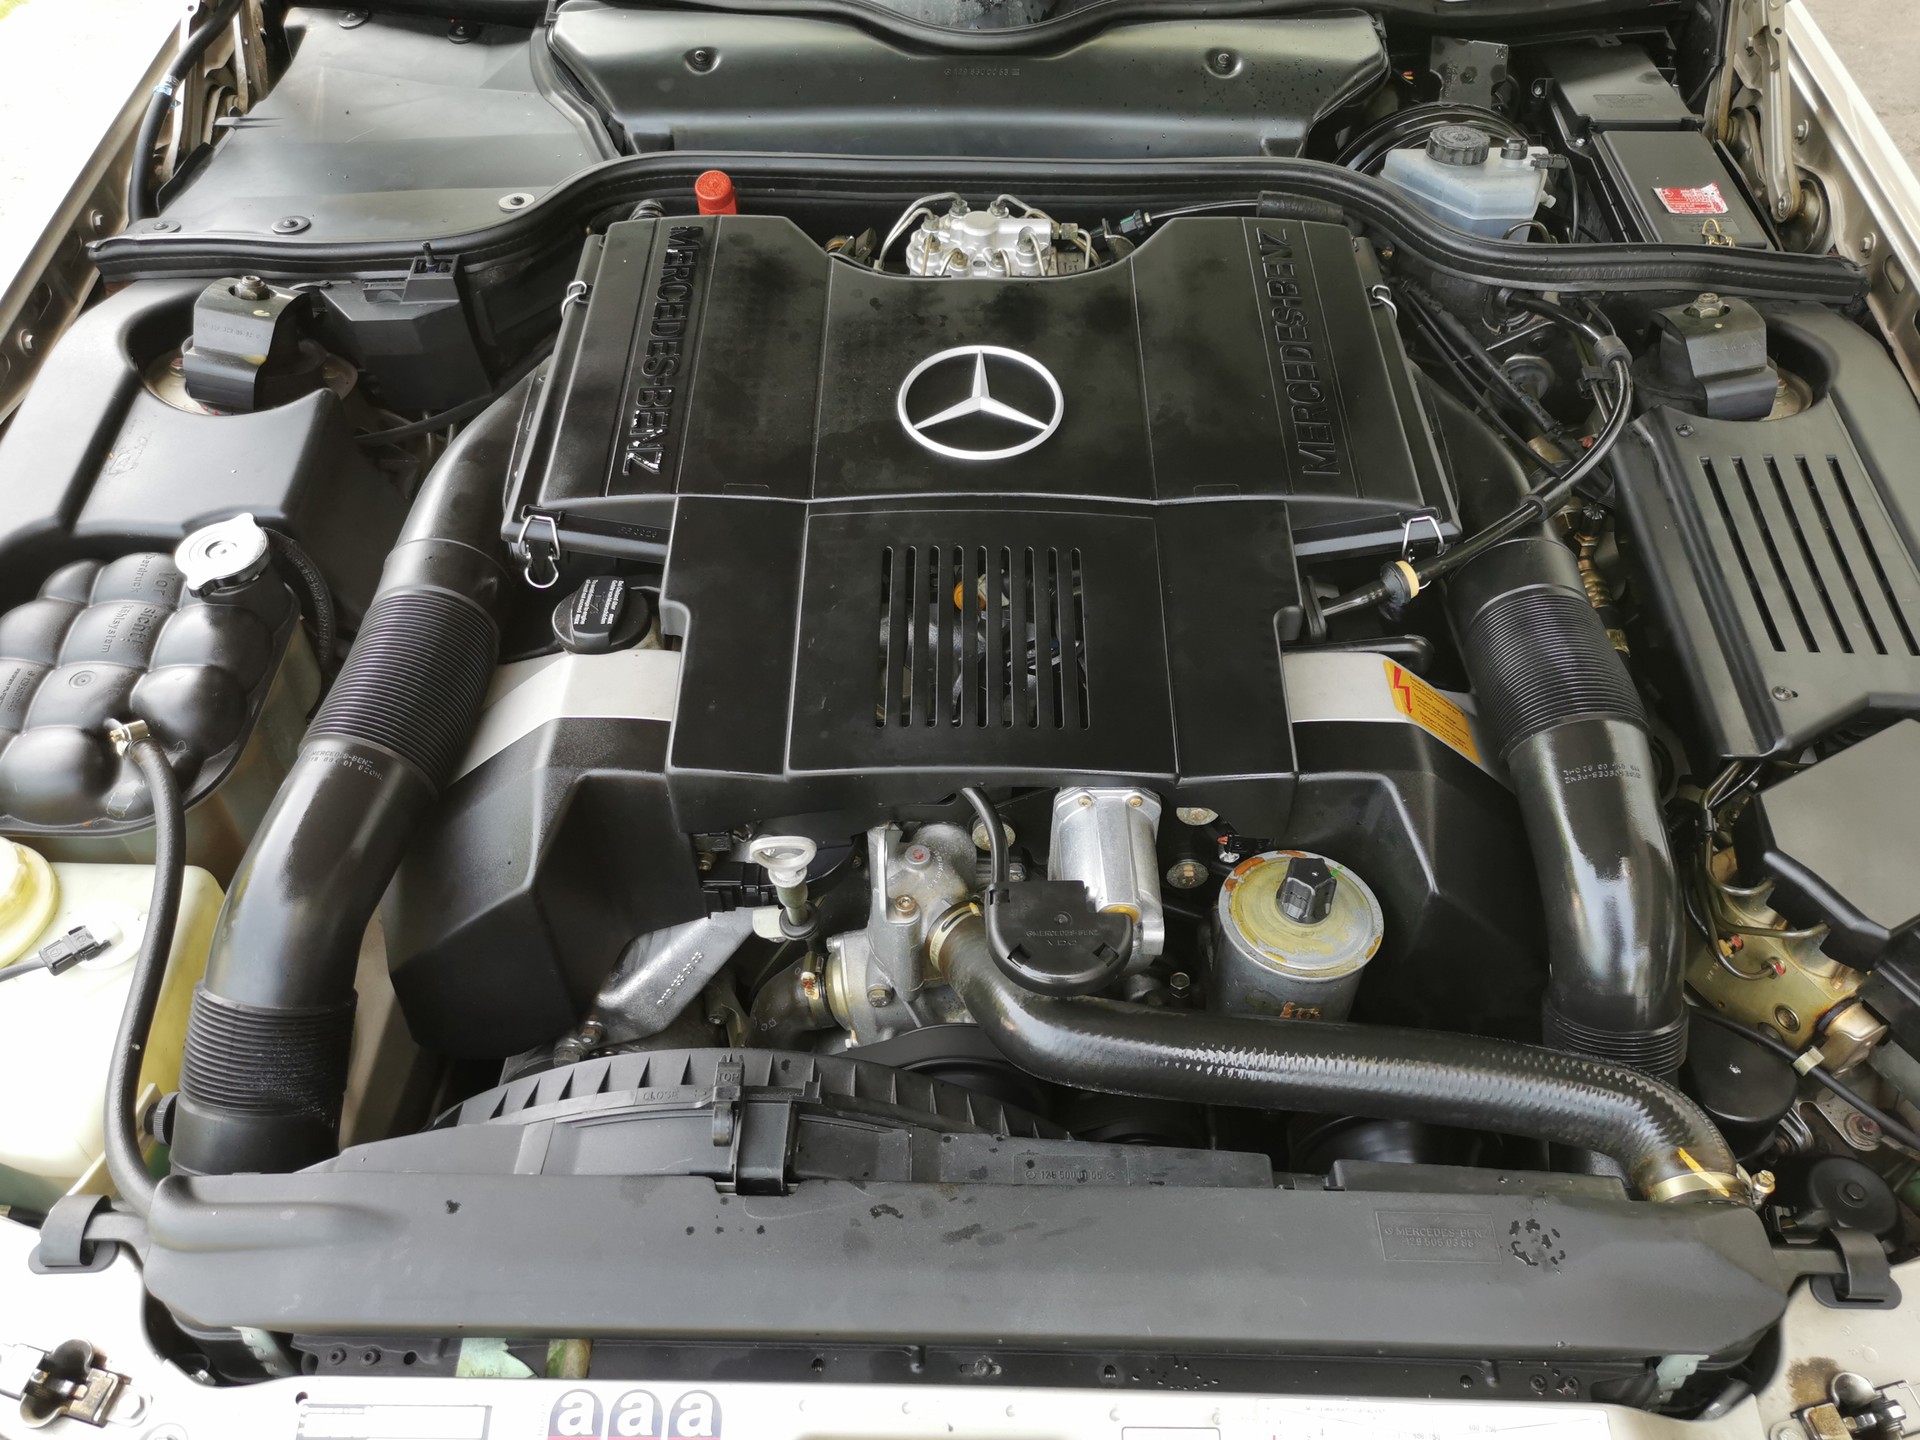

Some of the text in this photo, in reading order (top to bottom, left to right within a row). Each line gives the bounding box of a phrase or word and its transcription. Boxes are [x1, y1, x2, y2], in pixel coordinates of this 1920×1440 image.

[622, 226, 703, 475] MERCEDES-BENZ
[1256, 227, 1341, 474] MERCEDES-BENZ
[718, 1071, 740, 1083] TOP
